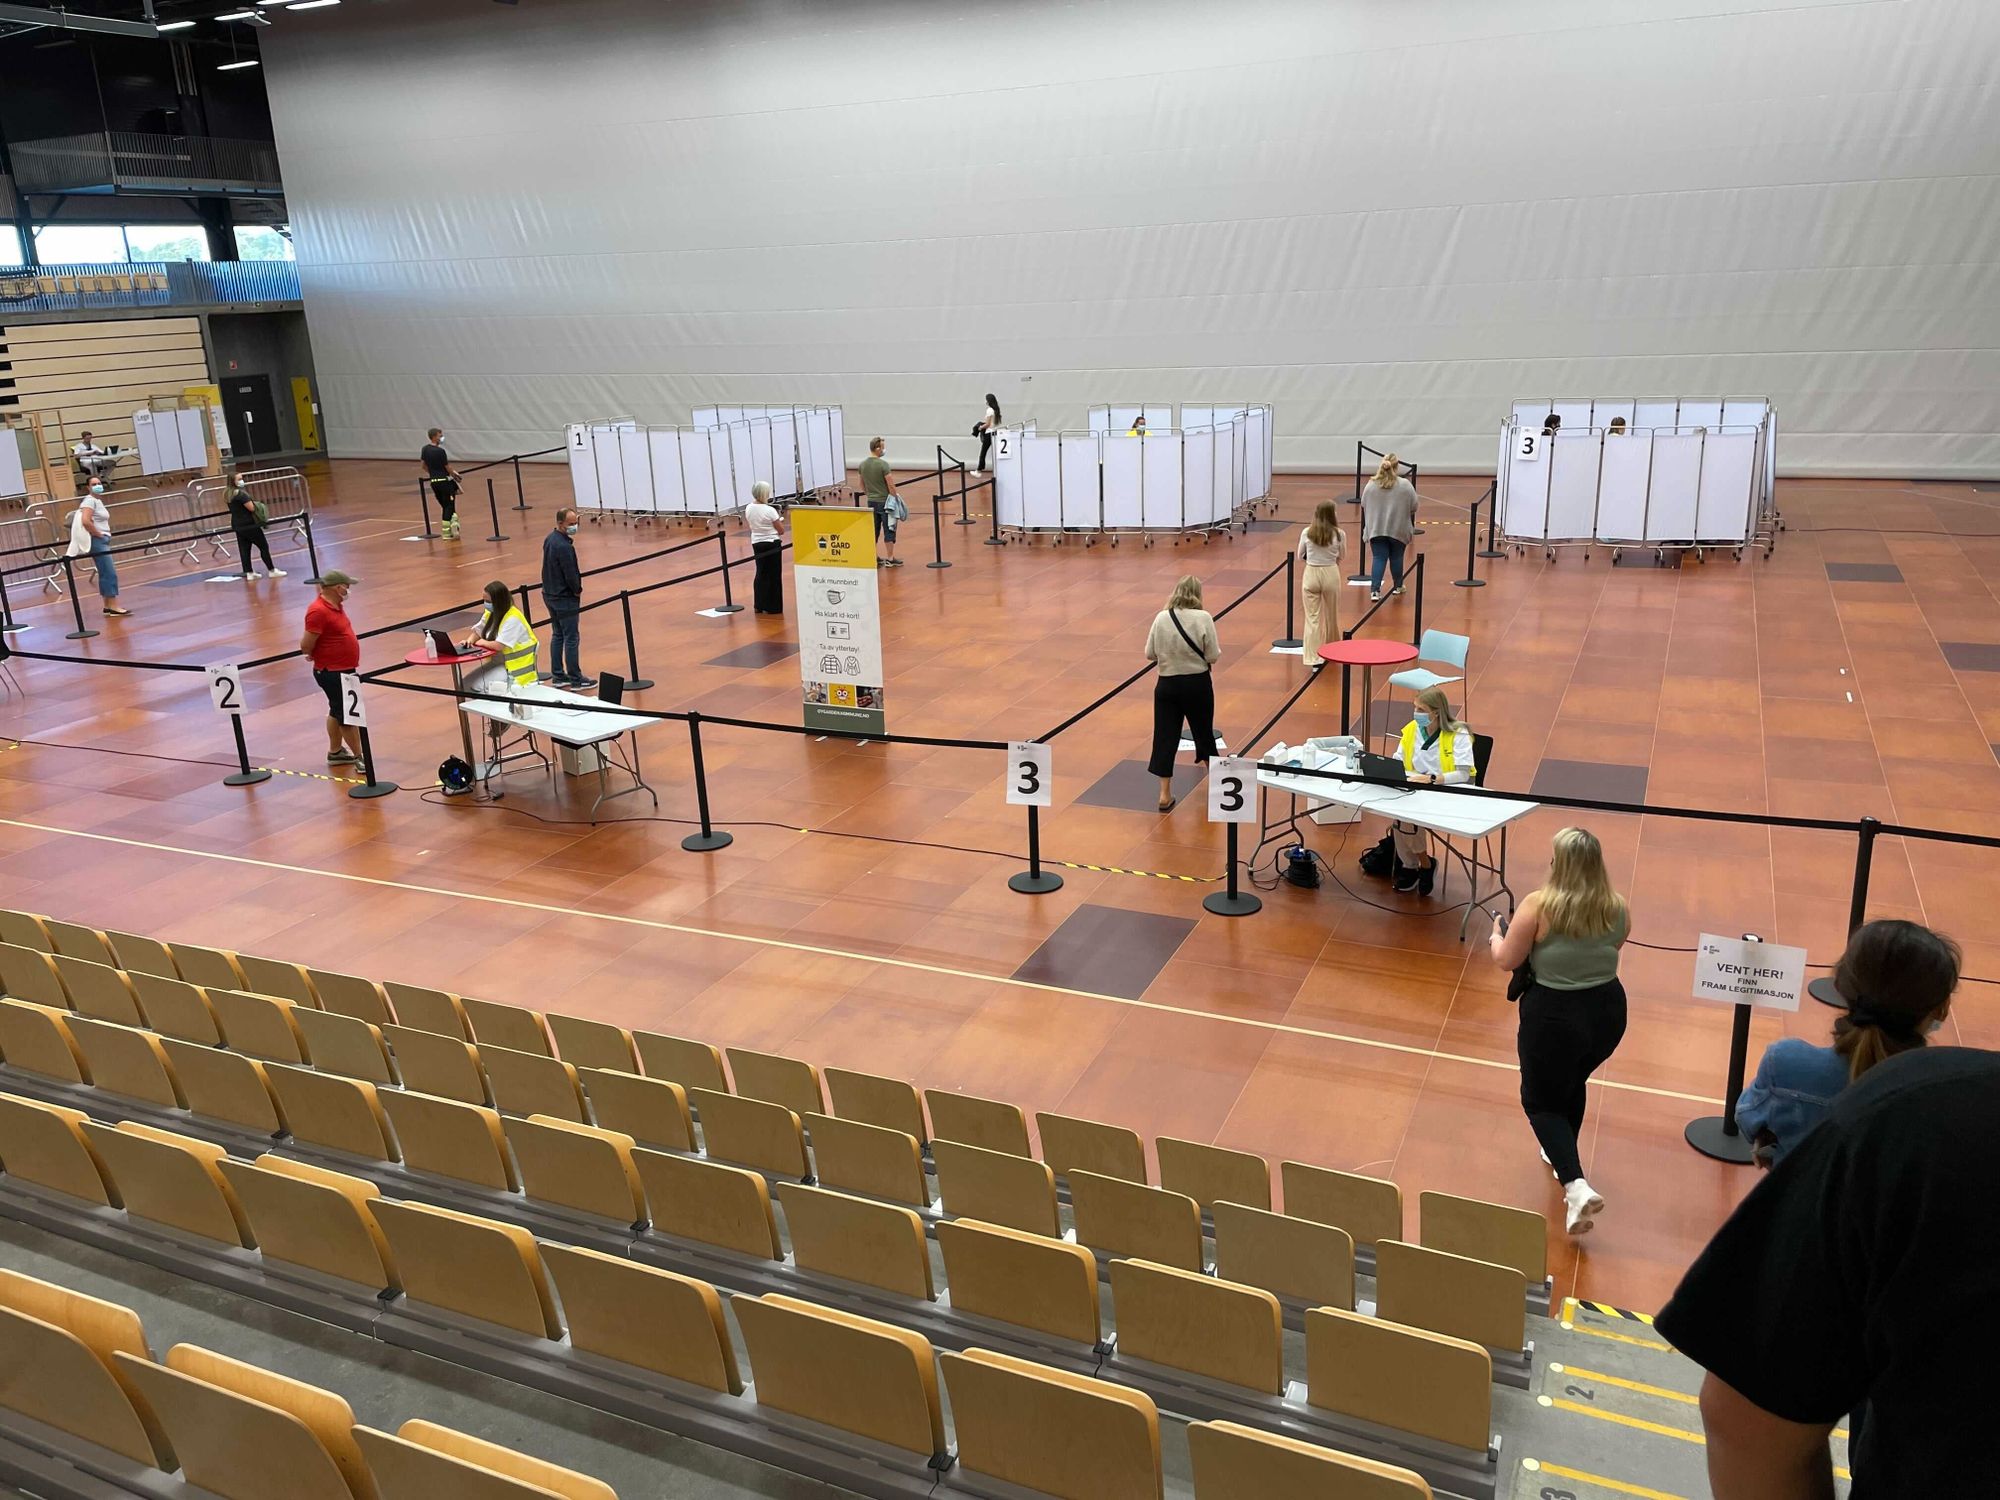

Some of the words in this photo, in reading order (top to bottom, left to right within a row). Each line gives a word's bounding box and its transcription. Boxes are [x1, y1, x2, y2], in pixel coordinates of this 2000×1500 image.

[575, 432, 583, 446] 1
[1000, 438, 1008, 454] 2
[1522, 437, 1534, 454] 3
[827, 578, 859, 586] munnbind!
[839, 612, 860, 620] id-kort!
[215, 676, 241, 709] 2
[347, 689, 360, 718] 2
[1017, 761, 1040, 795] 3
[1220, 776, 1244, 812] 3
[1716, 962, 1750, 976] VENT
[1753, 967, 1784, 980] HER!
[1701, 980, 1727, 991] FRAM
[1728, 985, 1795, 1000] LEGITIMASJON
[1737, 977, 1758, 986] FINN
[1564, 1384, 1594, 1401] 2
